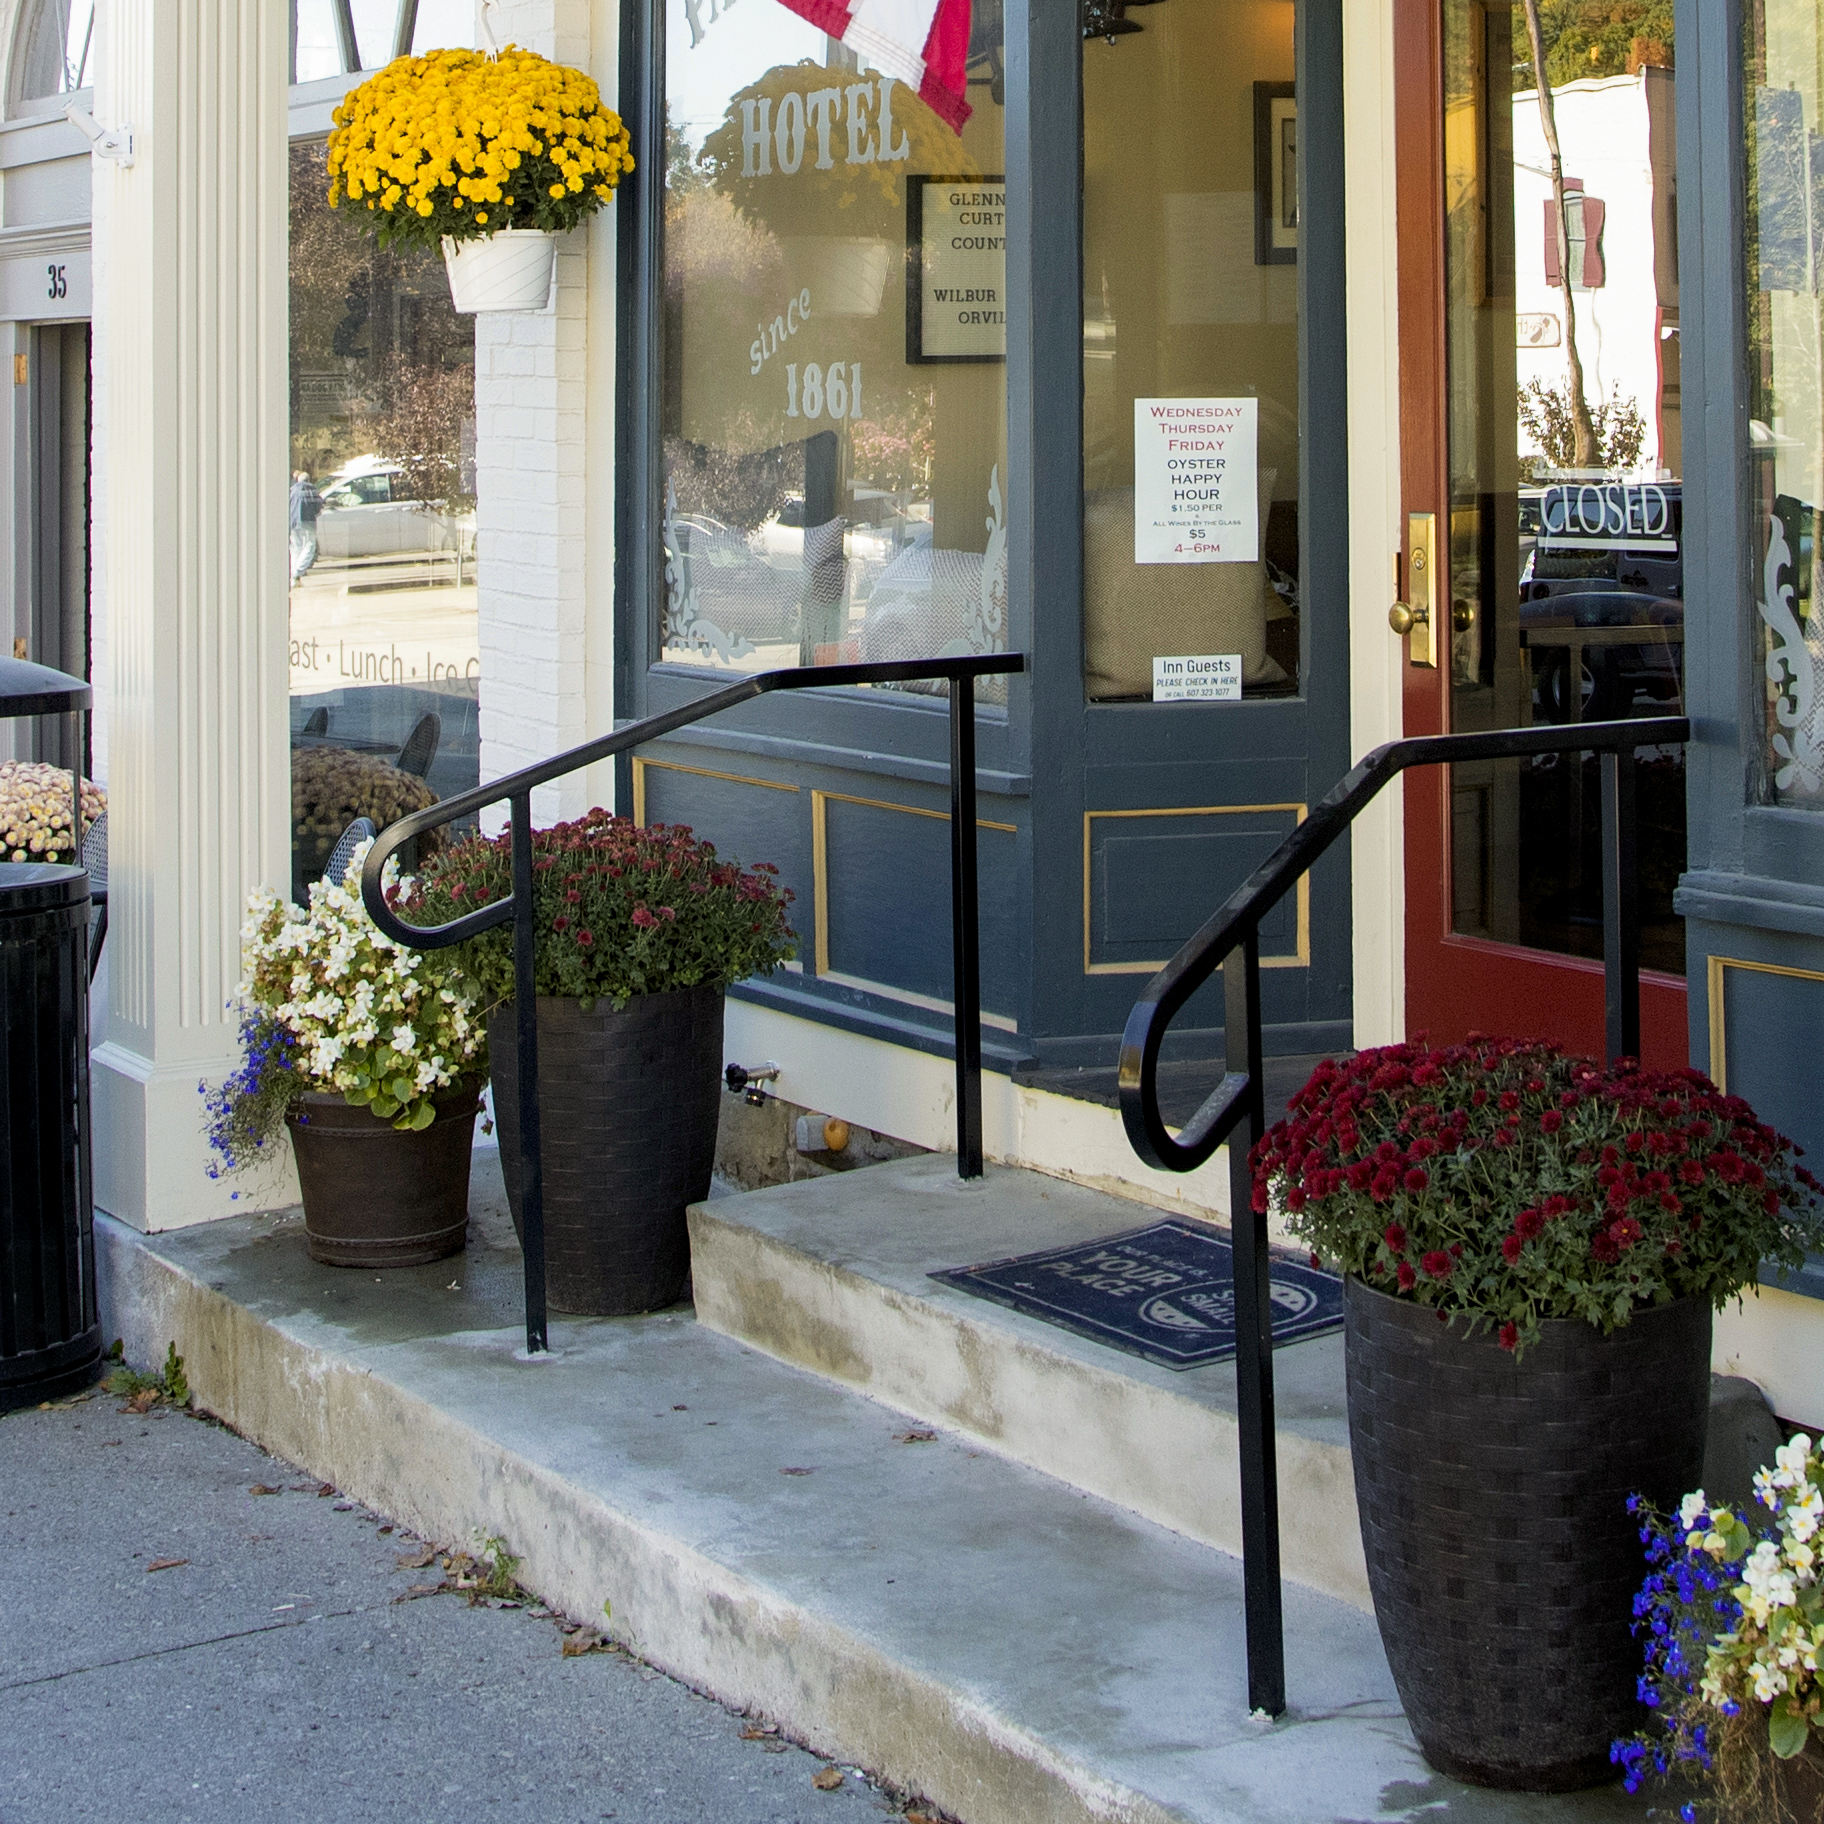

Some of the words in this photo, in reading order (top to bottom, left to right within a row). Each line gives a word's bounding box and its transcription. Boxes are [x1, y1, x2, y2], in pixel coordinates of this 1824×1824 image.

[739, 78, 910, 177] HOTEL
[48, 264, 67, 299] 35
[933, 289, 997, 302] WILBUR
[749, 287, 812, 376] since
[785, 361, 863, 420] 1861
[1150, 406, 1243, 418] WEDNESDAY
[1158, 423, 1234, 434] THURSDAY
[1168, 439, 1225, 451] FRIDAY
[1167, 459, 1226, 469] OYSTER
[1171, 474, 1222, 484] HAPPY
[1174, 489, 1220, 500] HOUR
[1171, 504, 1200, 512] $1.50
[1202, 504, 1223, 512] PER
[1540, 484, 1668, 535] CLOSED
[1189, 528, 1206, 539] $5
[340, 639, 404, 684] Lunch
[1163, 660, 1183, 673] Inn
[1187, 658, 1231, 673] Guests
[1156, 678, 1182, 687] PLEASE
[1185, 677, 1208, 686] CHECK
[1080, 1251, 1183, 1288] YOUR
[1039, 1261, 1146, 1297] PLACE
